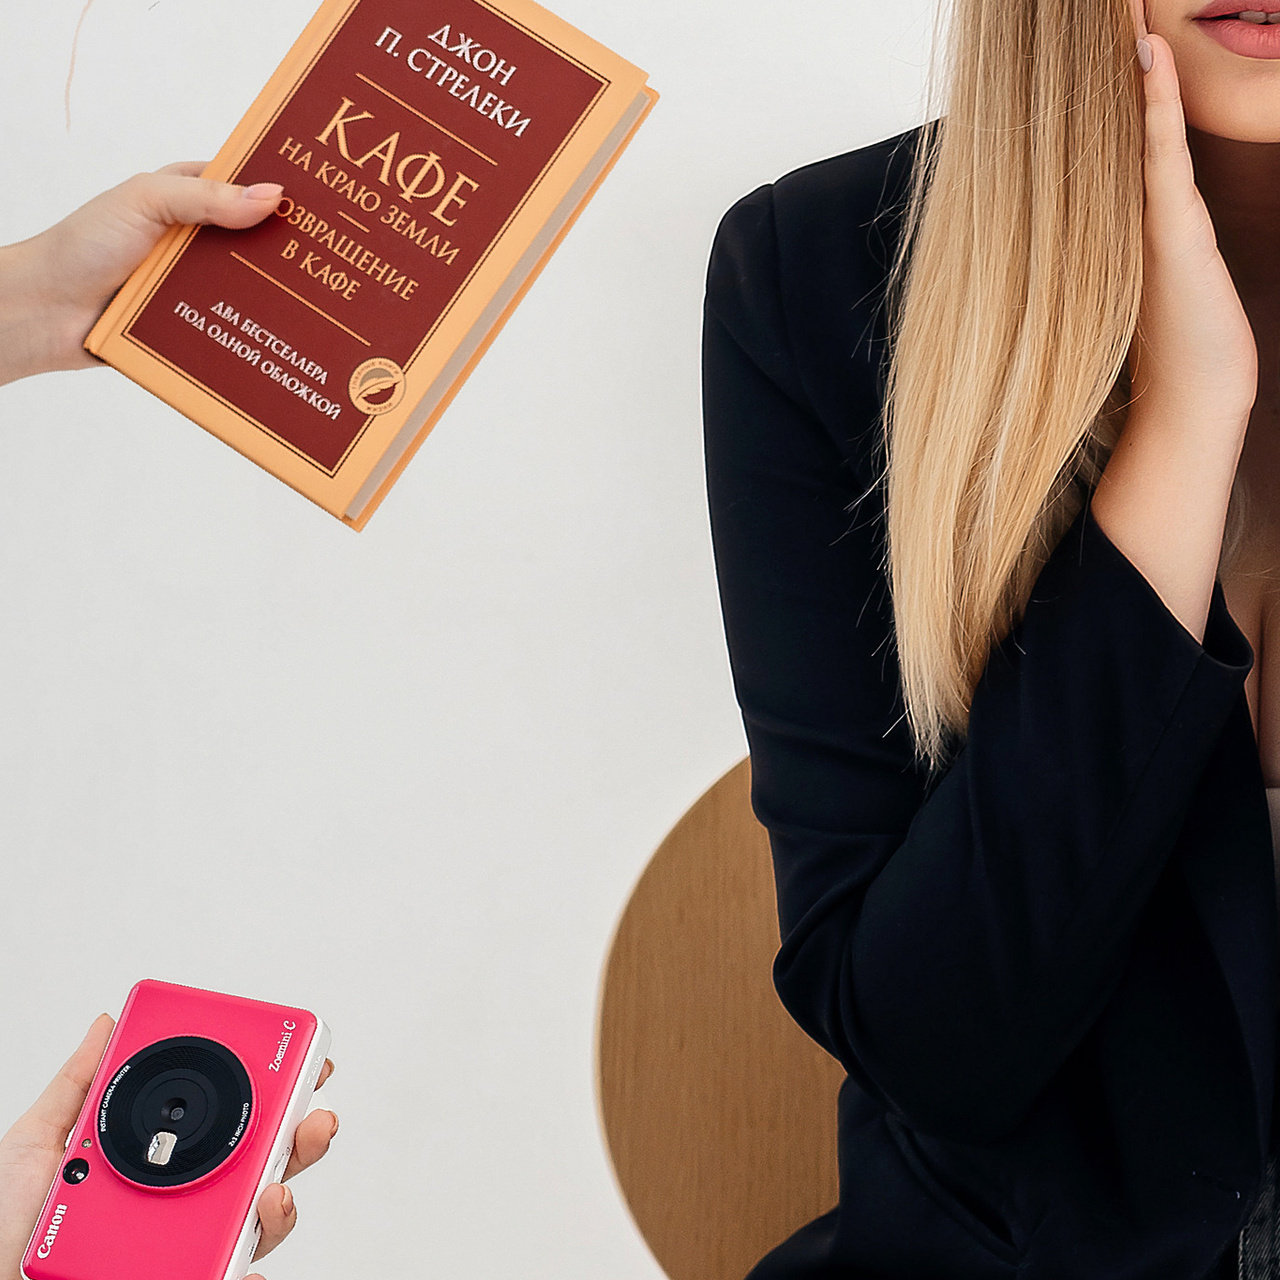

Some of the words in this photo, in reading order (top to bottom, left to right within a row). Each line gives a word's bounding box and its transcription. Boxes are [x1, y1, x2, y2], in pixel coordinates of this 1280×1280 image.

[374, 26, 403, 57] П.
[407, 48, 532, 137] СТРЕЛЕКИ
[428, 24, 517, 86] ДЖОН
[313, 97, 480, 227] КАФЕ
[278, 136, 313, 172] НА
[314, 161, 382, 212] КРАЮ
[380, 204, 460, 266] ЗЕМЛИ
[275, 197, 419, 301] ОЗВРАЩЕНИЕ
[280, 239, 300, 260] В
[300, 251, 361, 301] КАФЕ
[173, 301, 206, 332] ПОД
[206, 324, 262, 367] ОДНОЙ
[261, 360, 341, 421] ОБЛОЖКОЙ
[209, 301, 241, 326] ДВА
[240, 318, 328, 385] БЕСТСЕЛЛЕРА
[268, 1031, 293, 1073] Zoemini
[283, 1020, 296, 1031] C
[102, 1085, 116, 1109] CAMERA
[112, 1064, 131, 1086] PRINTER
[240, 1102, 250, 1123] PHOTO
[37, 1203, 68, 1259] Canon
